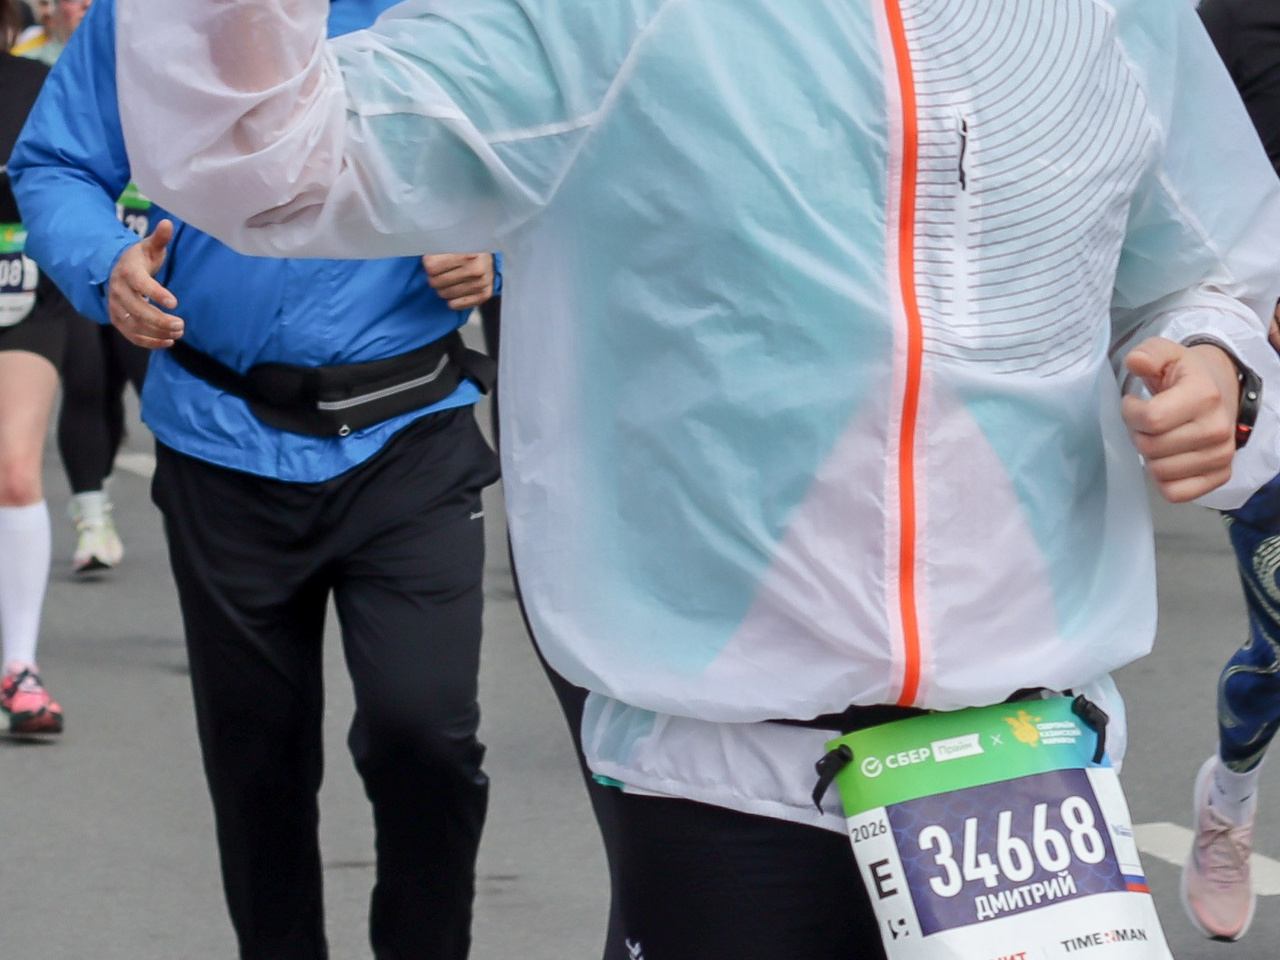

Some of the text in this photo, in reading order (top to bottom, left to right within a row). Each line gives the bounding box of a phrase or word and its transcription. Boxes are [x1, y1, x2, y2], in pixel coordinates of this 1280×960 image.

[885, 747, 931, 769] СБЕР
[851, 819, 888, 844] 2026
[918, 795, 1107, 898] 34668
[868, 858, 899, 900] E
[974, 871, 1078, 921] ДМИТРИЙ
